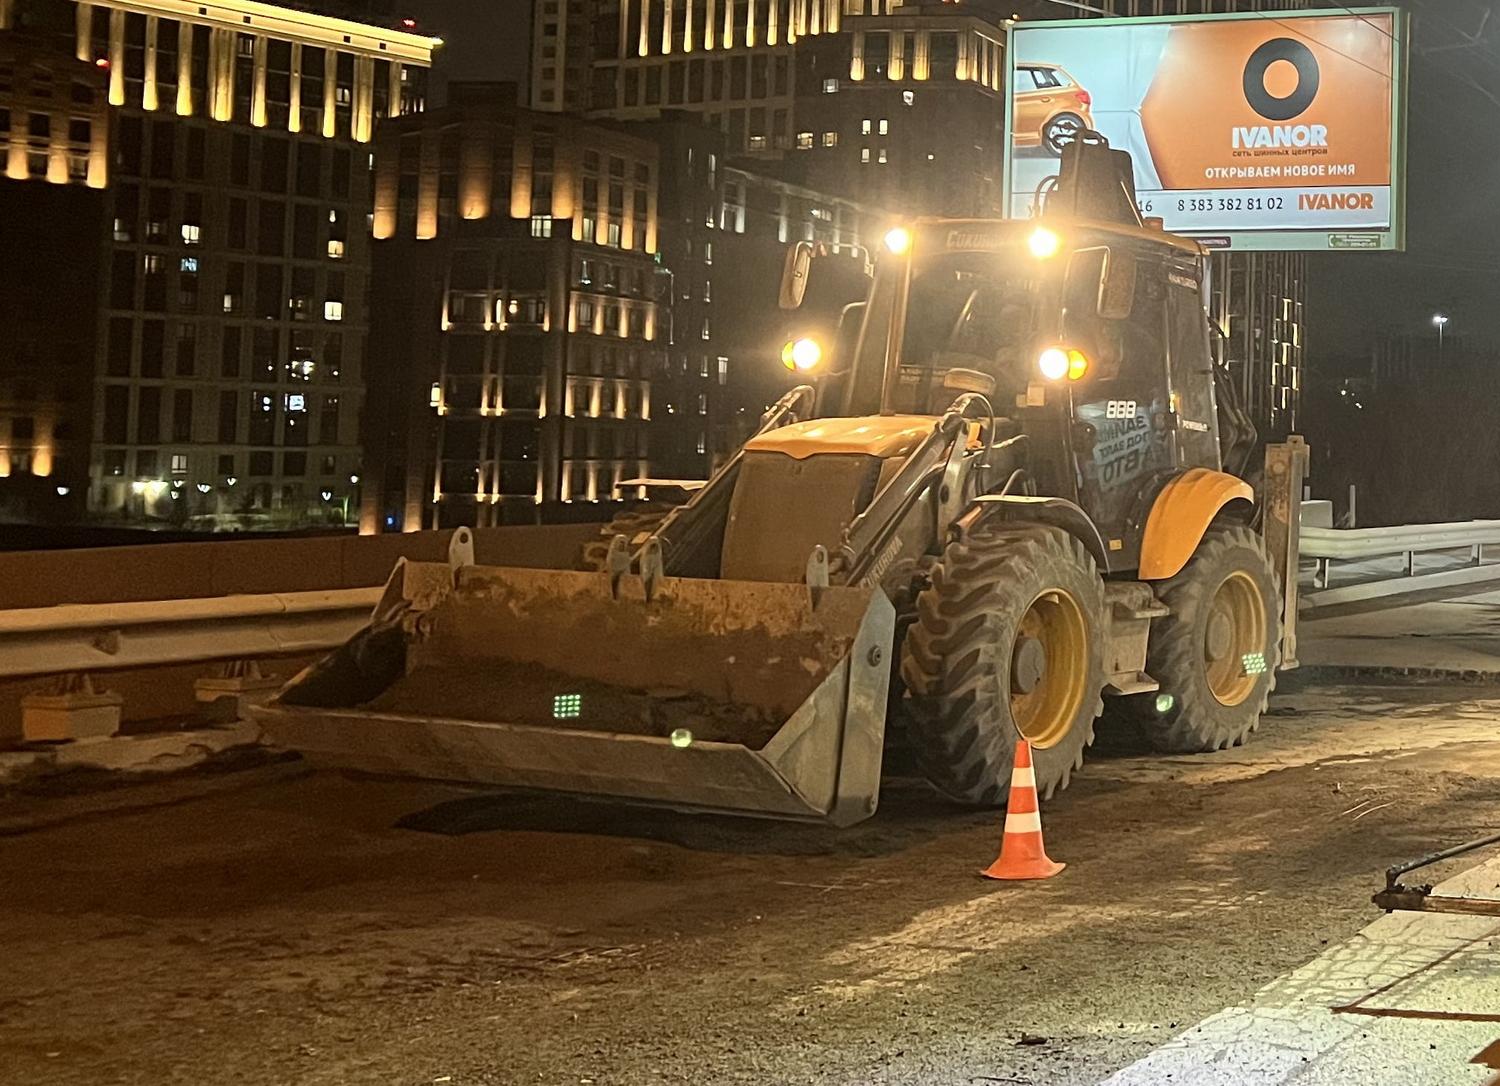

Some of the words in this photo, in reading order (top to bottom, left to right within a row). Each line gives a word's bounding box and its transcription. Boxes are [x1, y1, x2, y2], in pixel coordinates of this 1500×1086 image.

[1232, 124, 1328, 149] IVANOR
[1254, 150, 1290, 158] шинных
[1291, 148, 1328, 158] центров
[1205, 166, 1281, 179] ОТКРЫВАЕМ
[1283, 165, 1325, 177] НОВОЕ
[1327, 163, 1356, 176] ИМЯ
[1177, 199, 1185, 212] 8
[1189, 199, 1214, 211] 383
[1218, 198, 1242, 211] 382
[1246, 198, 1263, 210] 81
[1266, 197, 1284, 210] 02
[1298, 192, 1375, 210] IVANOR
[1106, 400, 1137, 419] 888
